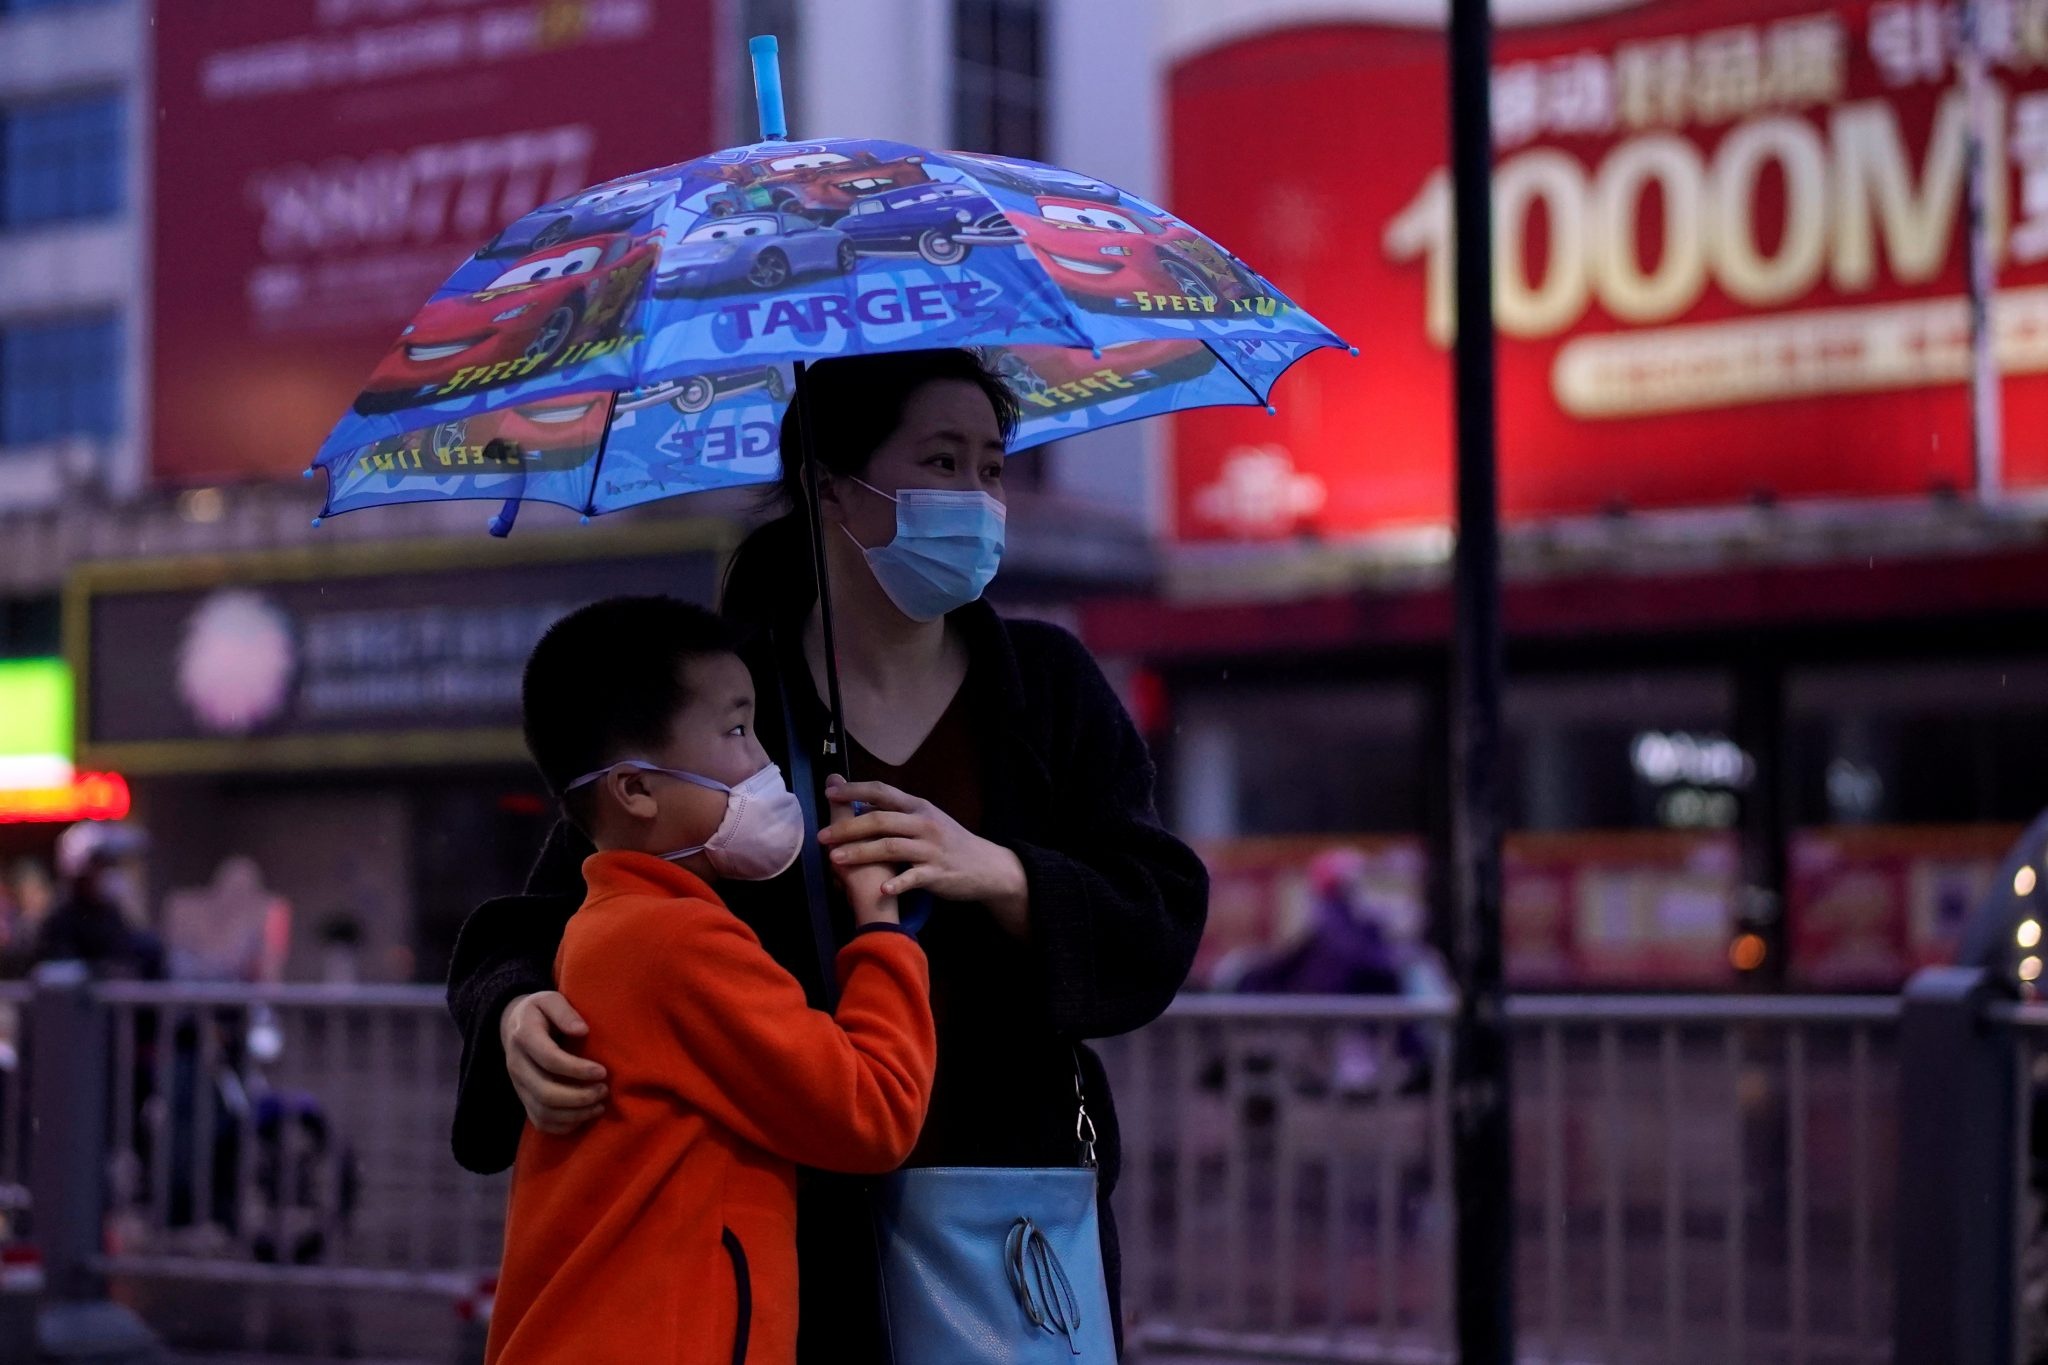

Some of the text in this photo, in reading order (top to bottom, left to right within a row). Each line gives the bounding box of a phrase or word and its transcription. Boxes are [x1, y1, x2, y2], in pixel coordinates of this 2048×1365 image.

[721, 280, 982, 341] TARGET
[1132, 291, 1216, 313] SPEED
[436, 351, 549, 396] SPEED
